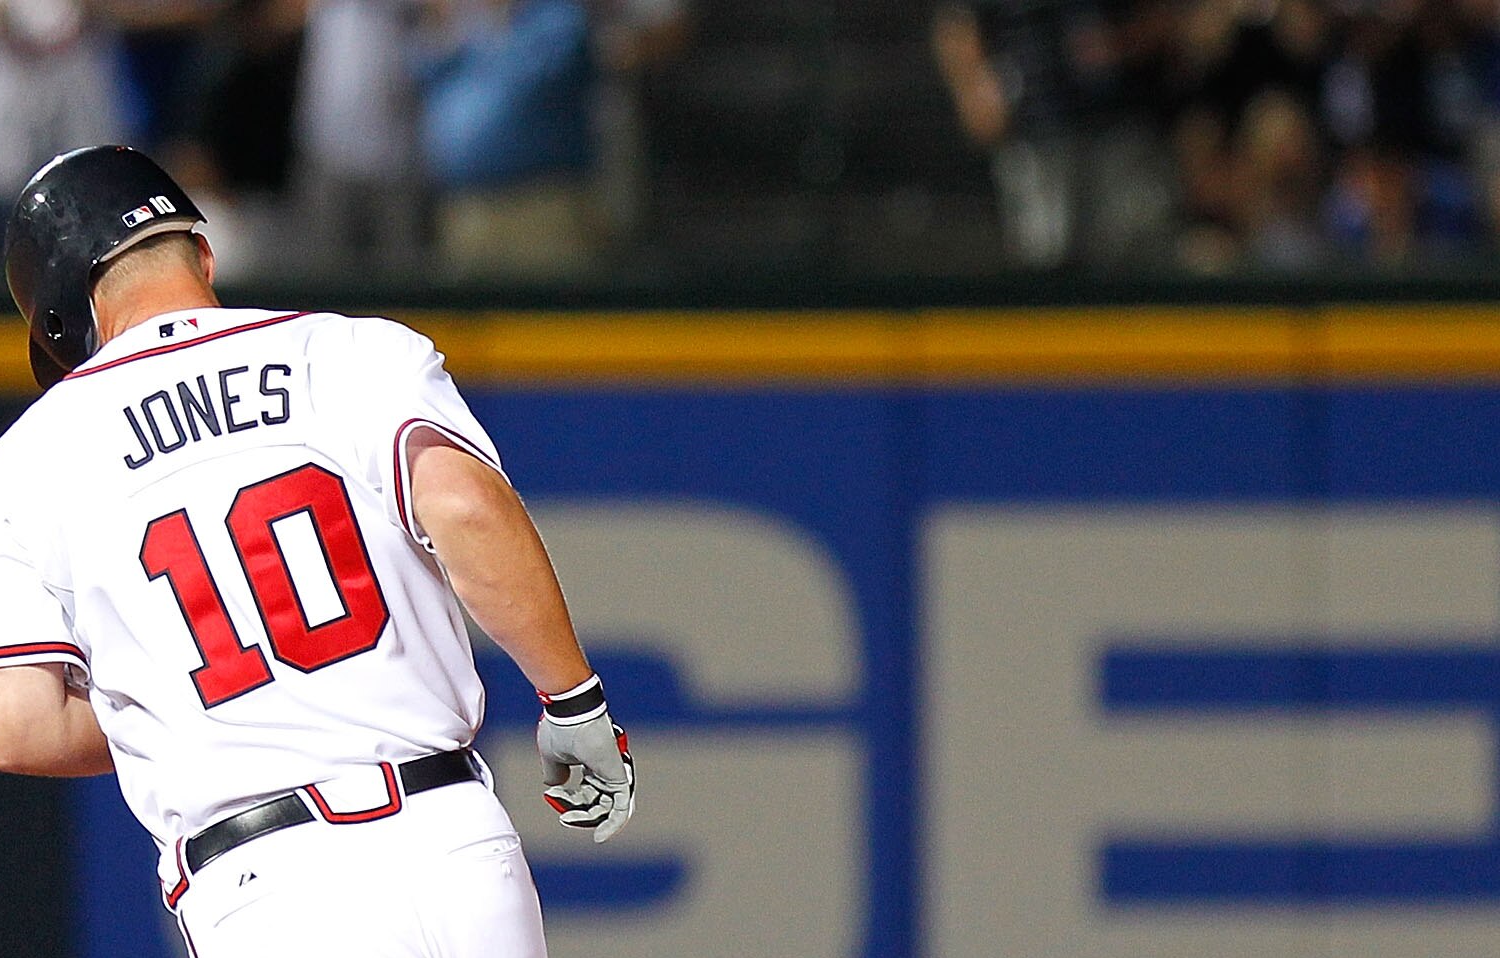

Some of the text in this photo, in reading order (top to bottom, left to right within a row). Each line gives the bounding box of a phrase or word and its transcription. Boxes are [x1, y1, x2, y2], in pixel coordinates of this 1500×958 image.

[148, 195, 177, 215] 10
[122, 363, 292, 470] JONES
[139, 462, 391, 711] 10
